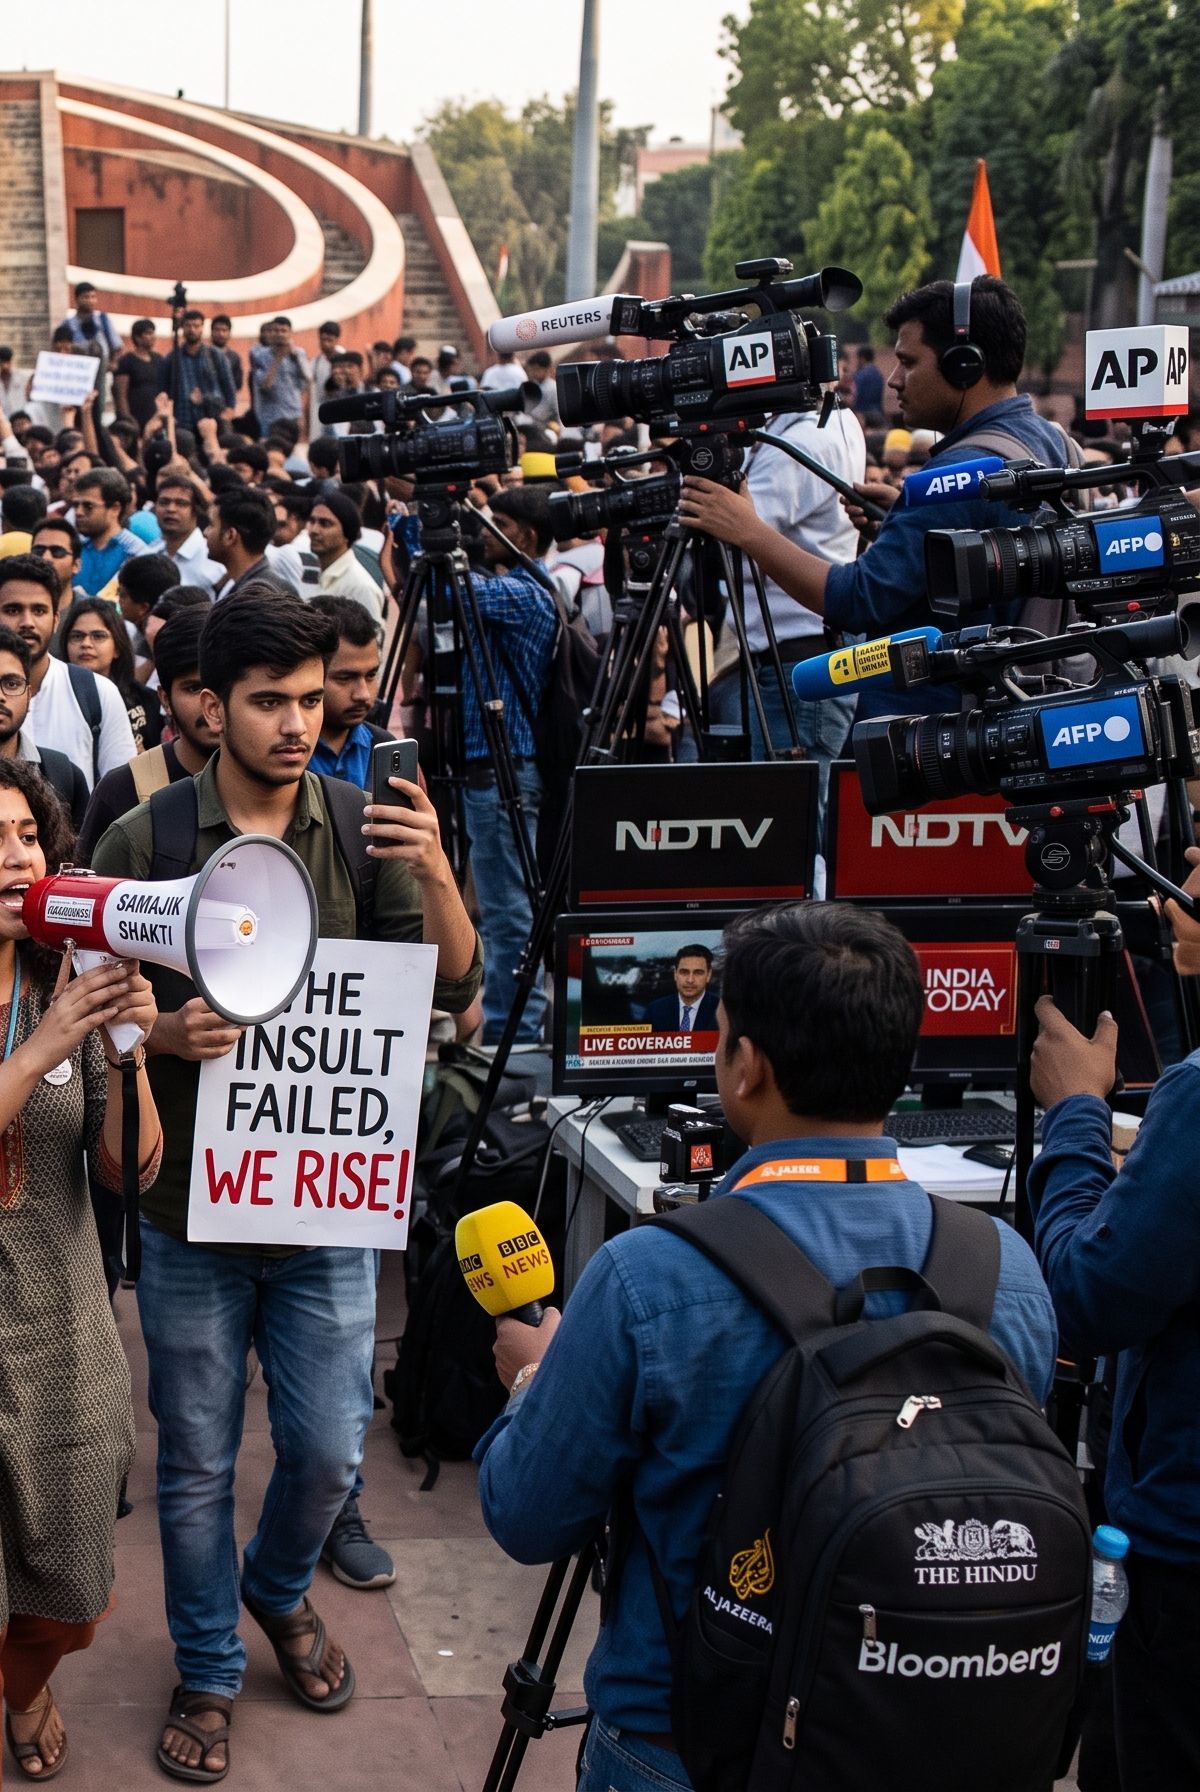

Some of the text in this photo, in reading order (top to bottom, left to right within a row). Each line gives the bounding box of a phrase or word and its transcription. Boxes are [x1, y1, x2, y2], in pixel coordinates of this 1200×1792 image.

[542, 311, 601, 331] REUTERS
[729, 343, 768, 371] AP
[1091, 348, 1158, 390] AP
[1166, 347, 1186, 385] AP
[926, 473, 971, 495] AFP
[1106, 537, 1143, 555] AFP
[1052, 723, 1101, 746] AFP
[616, 818, 773, 850] NDTV
[871, 814, 1029, 847] NDTV
[117, 894, 184, 915] SAMAJIK
[119, 921, 172, 945] SHAKTI
[927, 969, 994, 987] INDIA
[283, 971, 365, 1016] HE
[924, 989, 1006, 1011] ODAY
[235, 1025, 404, 1077] INSULT
[585, 1036, 691, 1051] LIVE COVERAGE
[227, 1083, 394, 1145] FAILED,
[206, 1149, 409, 1219] WE RISE!
[500, 1232, 539, 1256] BBC
[502, 1249, 549, 1279] NEWS
[915, 1565, 1037, 1584] THE HINDU
[859, 1639, 1061, 1678] Bloomberg
